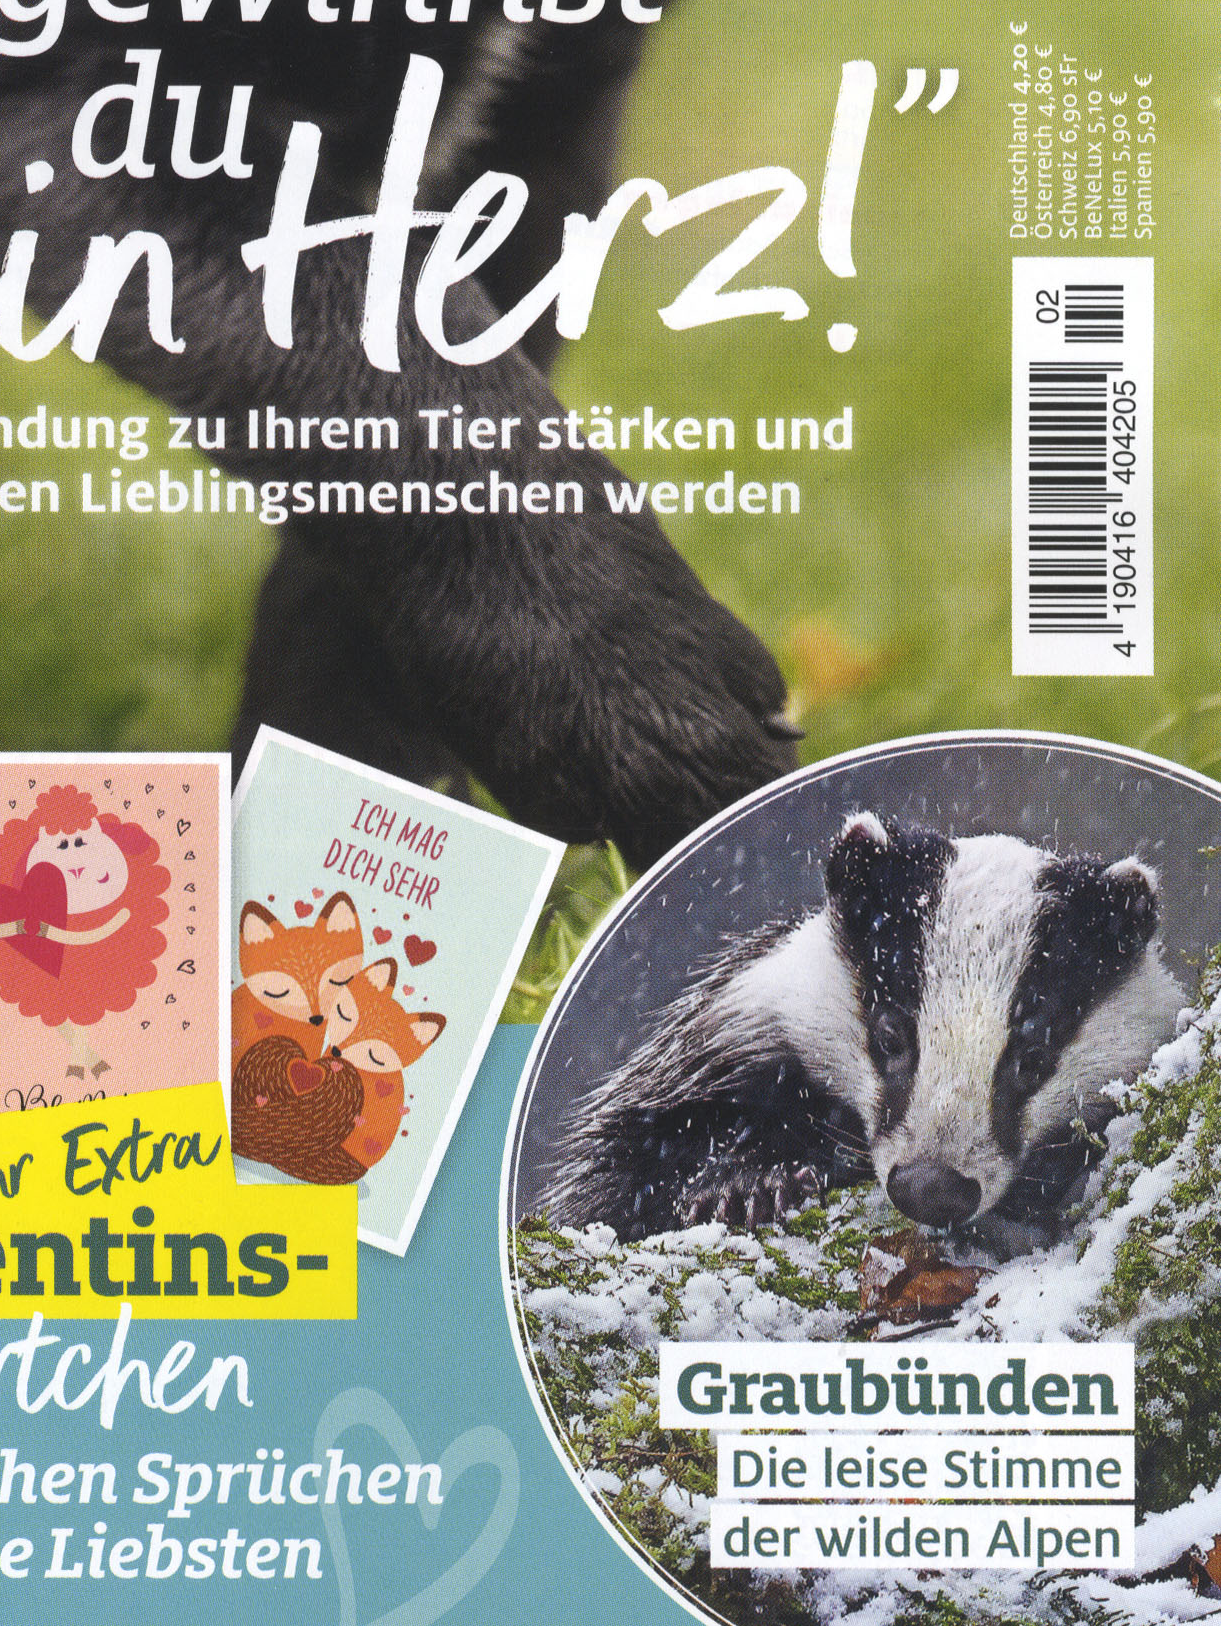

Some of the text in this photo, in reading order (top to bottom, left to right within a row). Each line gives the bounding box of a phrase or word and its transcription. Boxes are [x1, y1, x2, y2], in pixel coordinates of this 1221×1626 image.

[71, 50, 253, 179] du
[1008, 21, 1031, 238] Deutschland 4,20 €
[1030, 44, 1055, 238] Österreich 4,80 €
[1058, 54, 1080, 239] Schweiz 6,90 sFr
[1085, 68, 1106, 238] BeNeLux 5,10 €
[1108, 92, 1130, 238] Italien 5,90 €
[1133, 74, 1157, 239] Spanien 5,90 €
[1036, 290, 1059, 324] 02
[166, 418, 228, 452] zu
[245, 405, 400, 450] Ihrem
[418, 404, 522, 450] Tier
[536, 405, 738, 450] stärken
[754, 407, 856, 452] und
[80, 469, 586, 524] Lieblingsmenschen
[602, 470, 802, 516] werden
[1112, 381, 1136, 657] 4 190416 404205
[351, 799, 448, 860] ICH MAG
[323, 838, 440, 910] DICH SEHR
[62, 1118, 221, 1195] Extra
[677, 1357, 1118, 1415] Graubünden
[133, 1448, 444, 1518] Sprüchen
[734, 1446, 1121, 1488] Die leise Stimme
[44, 1522, 322, 1579] Liebsten
[724, 1516, 1119, 1567] der wilden Alpen
